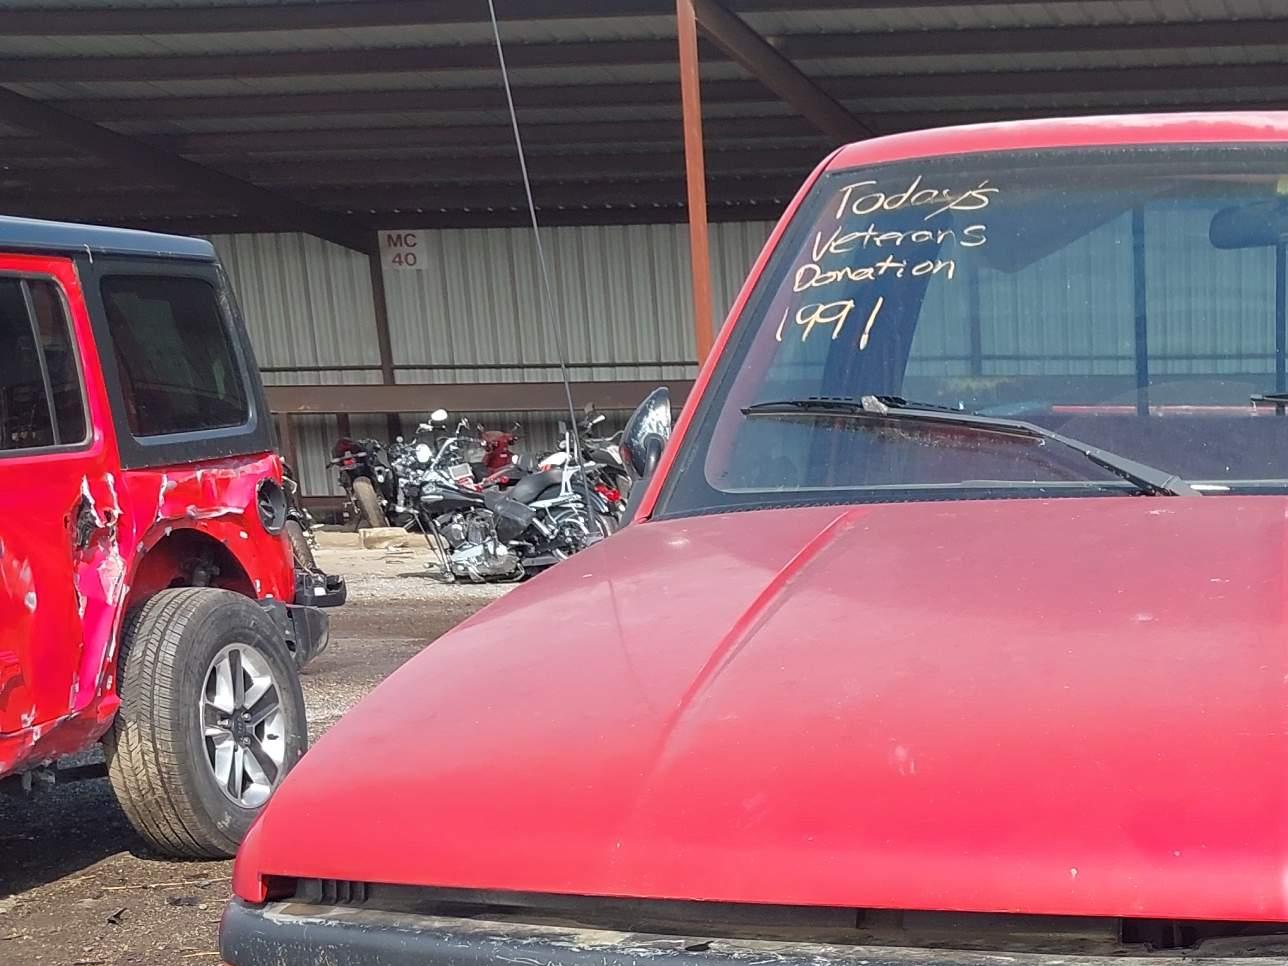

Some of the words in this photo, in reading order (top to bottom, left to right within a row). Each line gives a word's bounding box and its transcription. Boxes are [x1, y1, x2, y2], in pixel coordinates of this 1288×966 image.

[386, 233, 417, 248] MC
[391, 252, 417, 266] 40
[812, 223, 987, 262] Veterans
[793, 255, 955, 292] Donation
[775, 296, 883, 350] 1991
